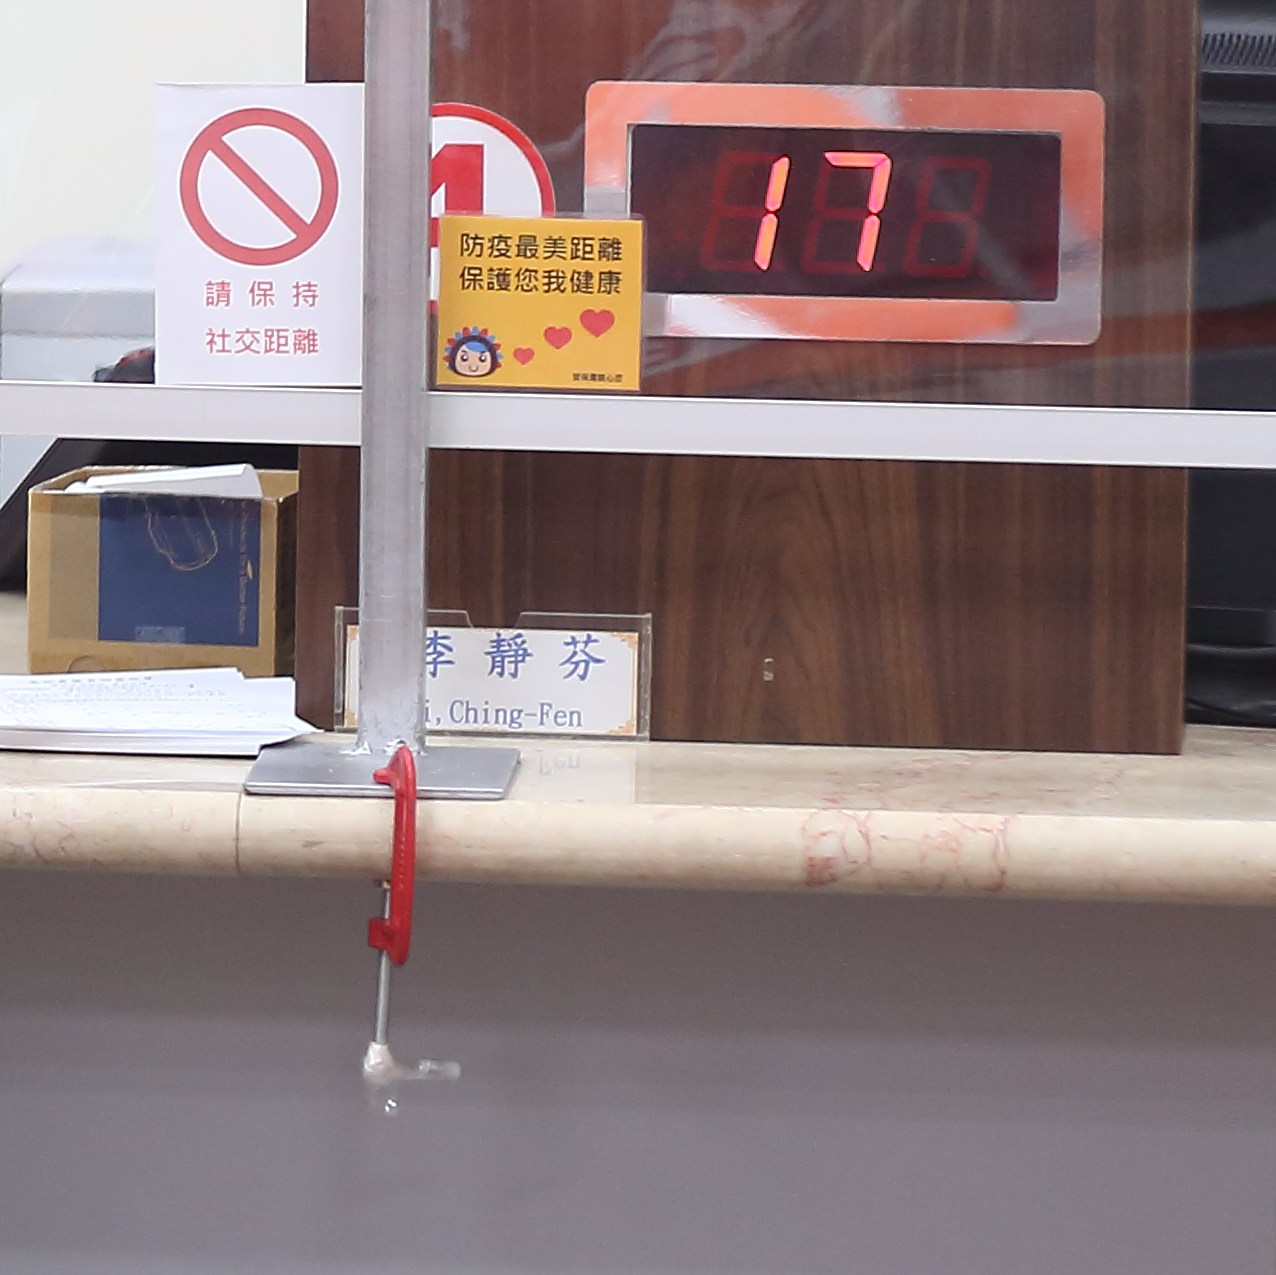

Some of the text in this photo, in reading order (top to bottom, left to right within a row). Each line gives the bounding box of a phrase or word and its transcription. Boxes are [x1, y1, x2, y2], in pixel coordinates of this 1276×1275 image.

[753, 151, 893, 272] 17
[459, 233, 623, 262] 防疫最美距離
[205, 280, 319, 308] 請保持
[459, 267, 622, 295] 保護您我健康
[205, 327, 319, 356] 社交距離
[424, 629, 606, 681] 李靜芬
[424, 699, 583, 729] i,Ching-Fen
